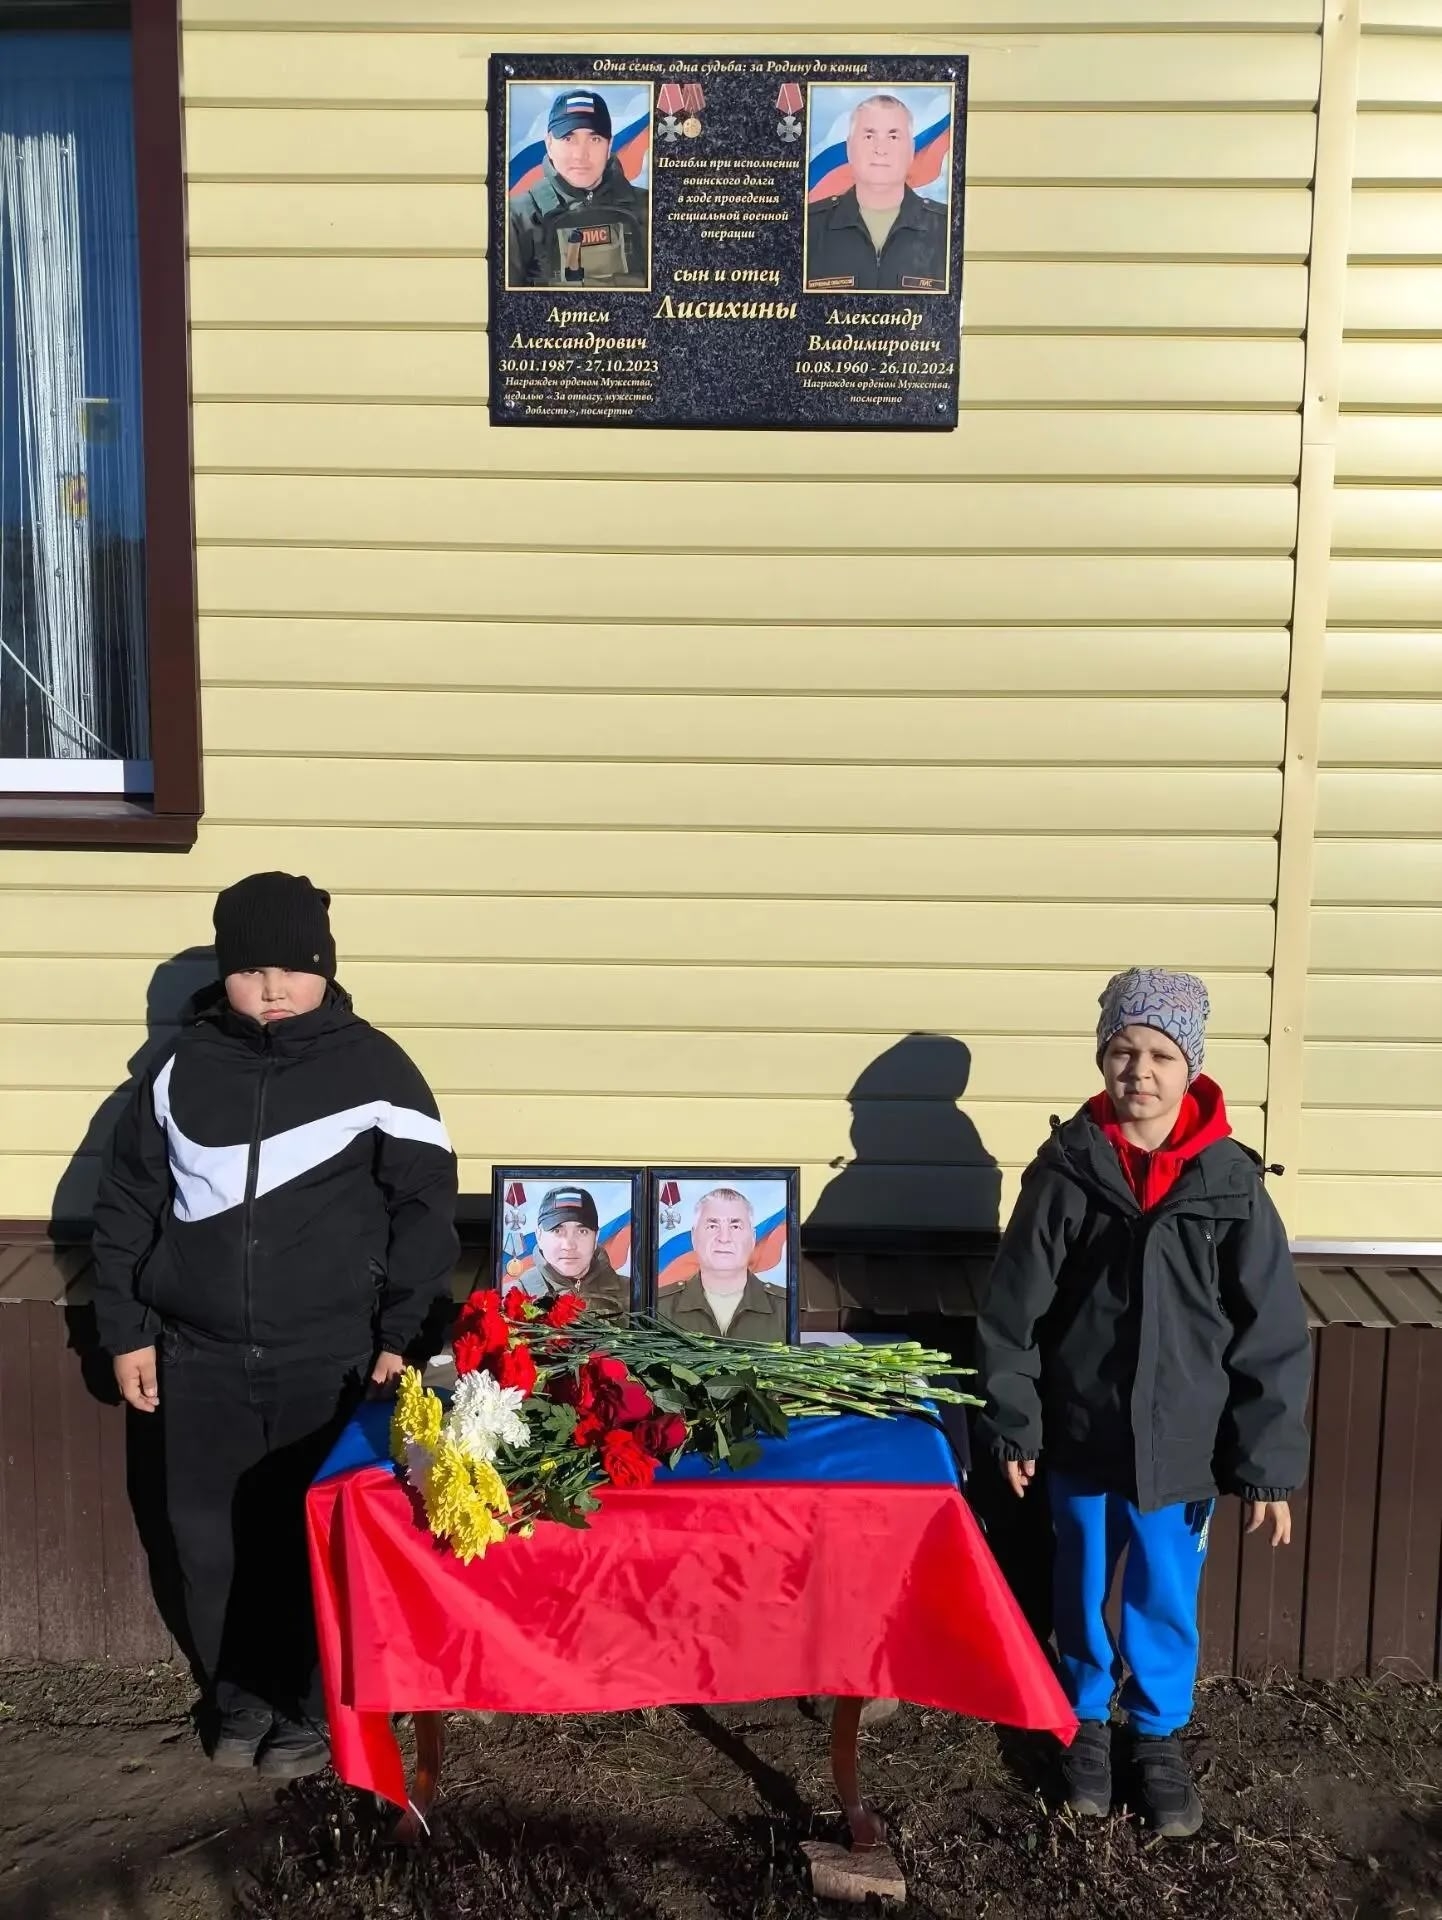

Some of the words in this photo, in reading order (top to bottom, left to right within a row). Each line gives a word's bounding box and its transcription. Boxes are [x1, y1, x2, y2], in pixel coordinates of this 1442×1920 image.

[593, 60, 625, 72] Одна
[629, 63, 666, 74] семья,
[669, 61, 698, 72] одна
[701, 61, 746, 75] судьба:
[750, 64, 763, 72] за
[767, 61, 811, 75] Родину
[813, 60, 827, 72] до
[830, 64, 867, 74] конца
[658, 157, 707, 168] Погибли
[710, 161, 732, 170] при
[734, 160, 799, 168] исполнении
[683, 176, 740, 185] воинского
[744, 175, 774, 185] долга
[687, 193, 711, 203] ходе
[714, 193, 779, 206] проведения
[668, 211, 739, 223] специальной
[743, 211, 789, 221] военной
[701, 229, 755, 241] операции
[674, 269, 709, 282] сын
[715, 269, 725, 281] и
[731, 270, 780, 286] отец
[653, 296, 797, 319] Лисихины
[546, 307, 610, 327] Артем
[826, 308, 922, 330] Александр
[510, 332, 647, 354] Александрович
[808, 335, 941, 356] Владимирович
[499, 360, 574, 371] 30.01.1987
[585, 360, 658, 372] 27.10.2023
[795, 362, 868, 373] 10.08.1960
[880, 362, 954, 374] 26.10.2024
[505, 377, 558, 390] Награжден
[560, 377, 598, 390] орденом
[600, 378, 652, 389] Мужества,
[803, 379, 855, 390] Награжден
[857, 379, 895, 390] орденом
[898, 380, 950, 390] Мужества,
[504, 391, 543, 400] медалью
[850, 396, 902, 404] посмертно
[525, 406, 578, 416] доблесть»,
[581, 408, 633, 417] посмертно
